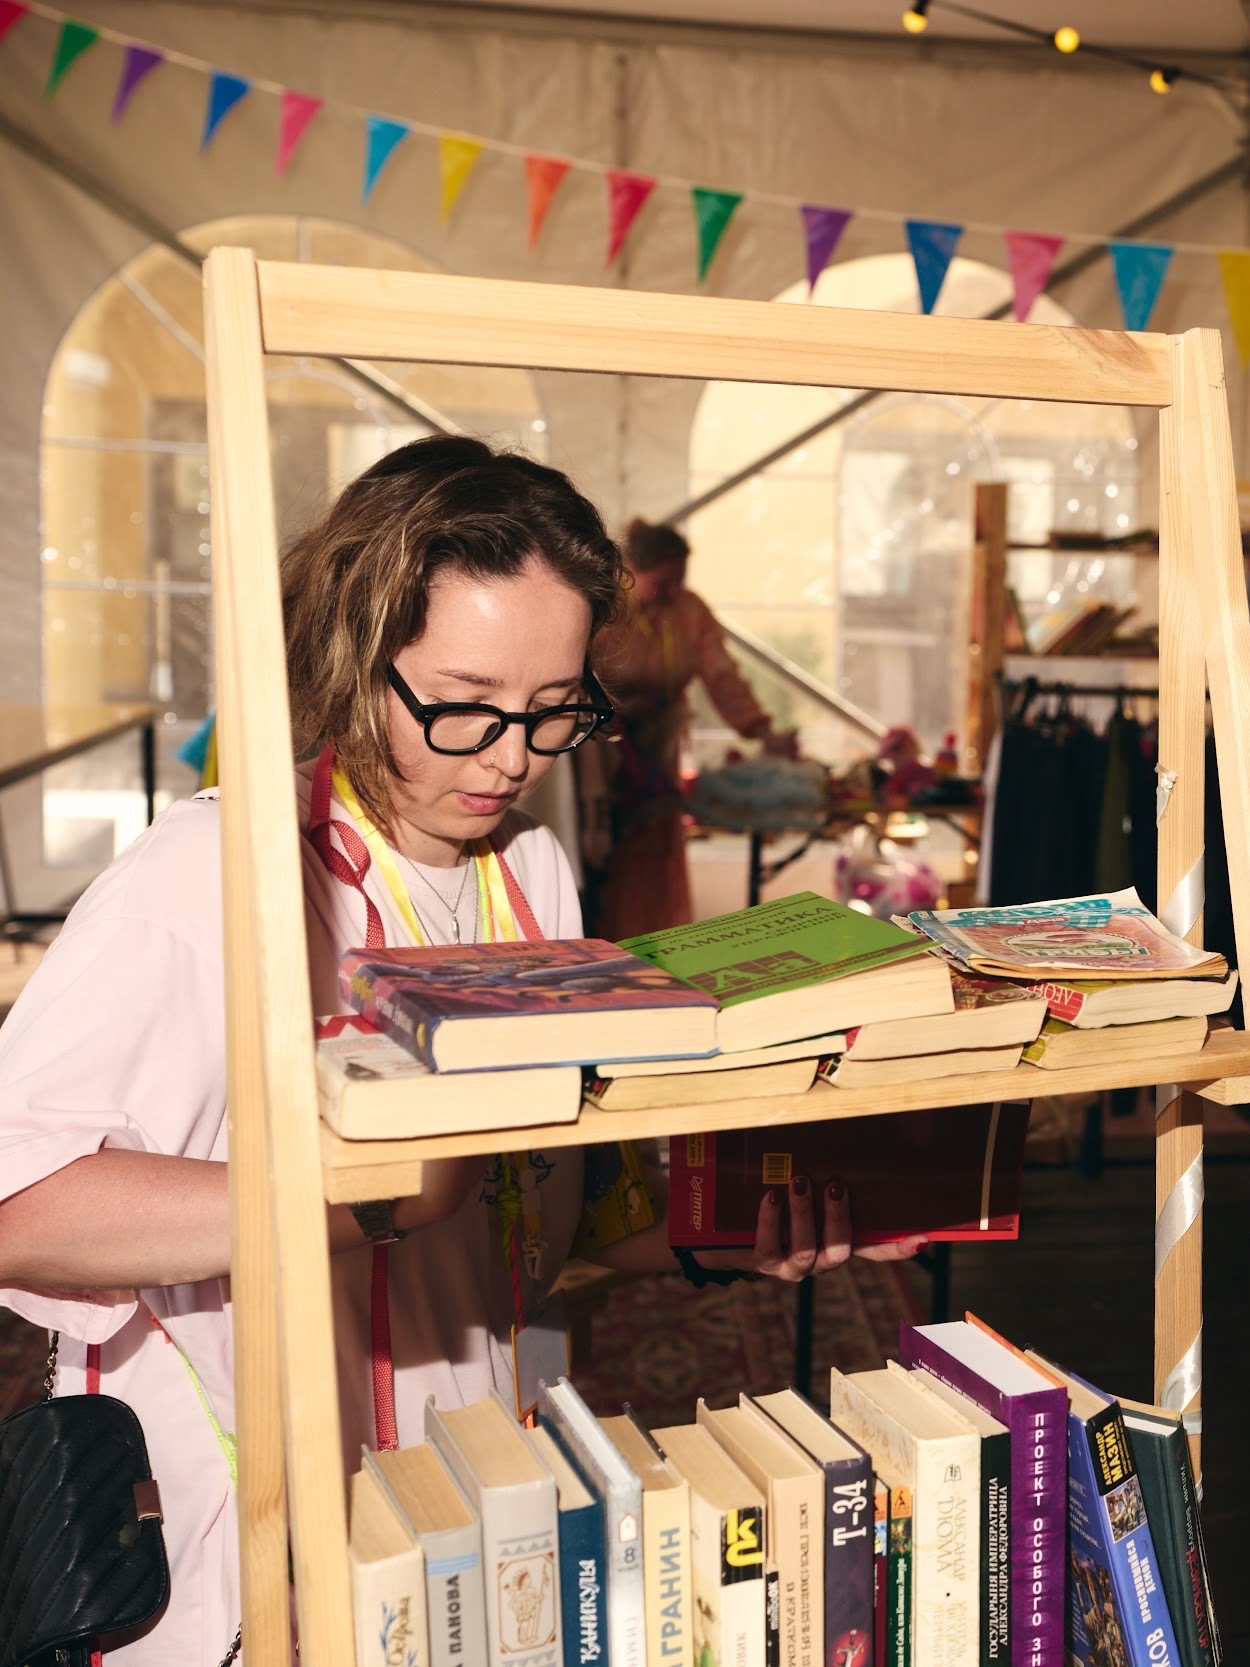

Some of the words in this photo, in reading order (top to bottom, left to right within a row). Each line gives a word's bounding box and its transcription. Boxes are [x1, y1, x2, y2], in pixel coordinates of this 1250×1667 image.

[643, 905, 835, 961] ГРАММАТИКА
[647, 911, 743, 940] АНГЛИЙСКИЙ
[693, 1191, 702, 1231] ПИТЕР
[1032, 1413, 1046, 1507] ПРОЕКТ
[1095, 1430, 1114, 1487] АЛЕКСАНДР
[1102, 1422, 1125, 1484] МАЗИН
[799, 1502, 809, 1529] ВСЕ
[833, 1479, 867, 1547] Т-34
[937, 1496, 953, 1574] ДЮМА
[953, 1497, 967, 1582] АЛЕКСАНДР
[988, 1477, 998, 1572] ИМПЕРАТРИЦА
[998, 1486, 1008, 1562] ФЕДОРОВНА
[624, 1546, 635, 1564] 8
[659, 1526, 682, 1658] ГРАНИН
[786, 1581, 795, 1593] В
[800, 1534, 811, 1651] ПРОИЗВЕДЕНИЯ
[1031, 1518, 1045, 1628] ОСОБОГО
[1126, 1539, 1151, 1624] ПРОСНУВШИЙСЯ
[1138, 1557, 1159, 1593] ДЕМОН
[446, 1574, 462, 1655] ПАНОВА
[578, 1558, 601, 1666] КАНИКУЛЫ
[988, 1574, 998, 1659] ГОСУДАРЫНЯ
[998, 1563, 1008, 1646] АЛЕКСАНДРА
[1186, 1546, 1209, 1649] ДЕЗИНСЕКТОР
